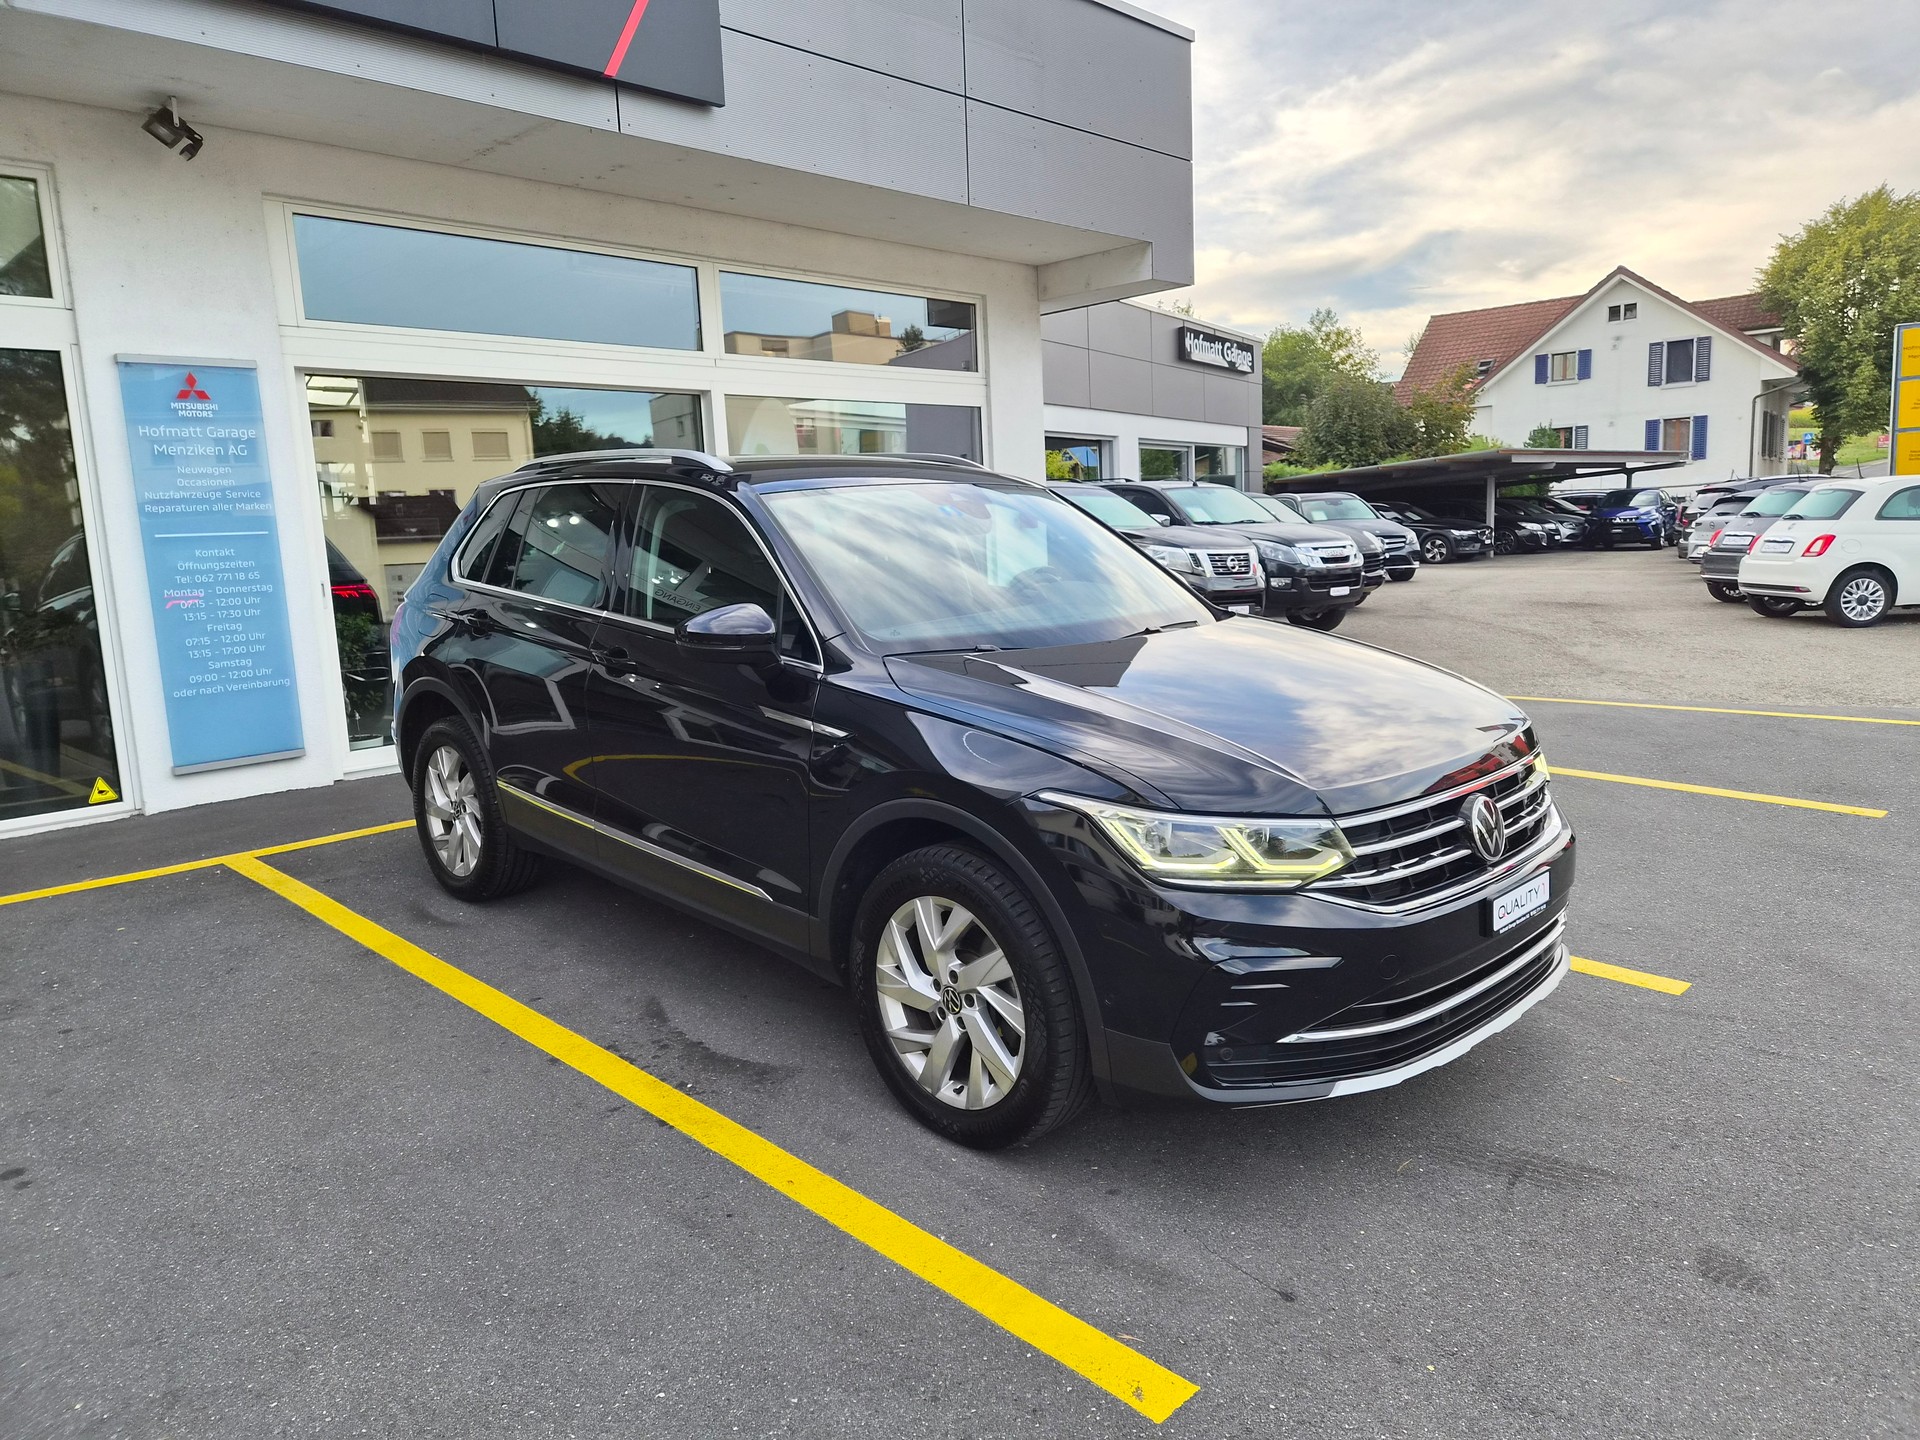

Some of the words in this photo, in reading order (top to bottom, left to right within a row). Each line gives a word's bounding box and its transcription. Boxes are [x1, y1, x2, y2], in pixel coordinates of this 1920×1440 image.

[1187, 332, 1223, 358] Hofmatt
[1224, 342, 1252, 367] Garage
[171, 402, 218, 411] MITSUBISHI
[178, 410, 213, 418] MOTORS
[138, 425, 203, 438] Hofmatt
[207, 426, 256, 440] Garage
[154, 444, 224, 455] Menziken
[228, 445, 247, 455] AG
[177, 465, 231, 476] Neuwagen
[177, 478, 235, 487] Occasionen
[145, 490, 221, 500] Nutzfahrzeuge
[226, 490, 261, 498] Service
[145, 504, 209, 514] Reparaturen
[212, 503, 232, 511] aller
[236, 502, 272, 510] Marken
[195, 548, 235, 557] Kontakt
[178, 560, 255, 571] Öffnungszeiten
[175, 575, 192, 584] Tel:
[195, 574, 214, 583] 062
[217, 573, 233, 581] 771
[235, 572, 246, 580] 18
[249, 571, 260, 580] 65
[164, 589, 204, 597] Montag
[216, 584, 273, 594] Donnerstag
[180, 600, 205, 609] 07:15
[216, 598, 241, 606] 12:00
[244, 596, 261, 605] Uhr
[184, 612, 207, 621] 13:15
[217, 609, 241, 618] 17:30
[244, 608, 261, 617] Uhr
[207, 623, 242, 632] Freitag
[185, 637, 210, 647] 07:15
[221, 634, 246, 643] 12:00
[249, 632, 266, 641] Uhr
[189, 649, 211, 659] 13:15
[222, 647, 246, 655] 17:00
[249, 644, 266, 652] Uhr
[208, 658, 252, 670] Samstag
[190, 673, 218, 684] 09:00
[228, 670, 253, 679] 12:00
[256, 668, 272, 676] Uhr
[174, 688, 198, 698] oder
[200, 684, 224, 695] nach
[226, 678, 290, 692] Vereinbarung
[1498, 884, 1540, 920] QUALITY
